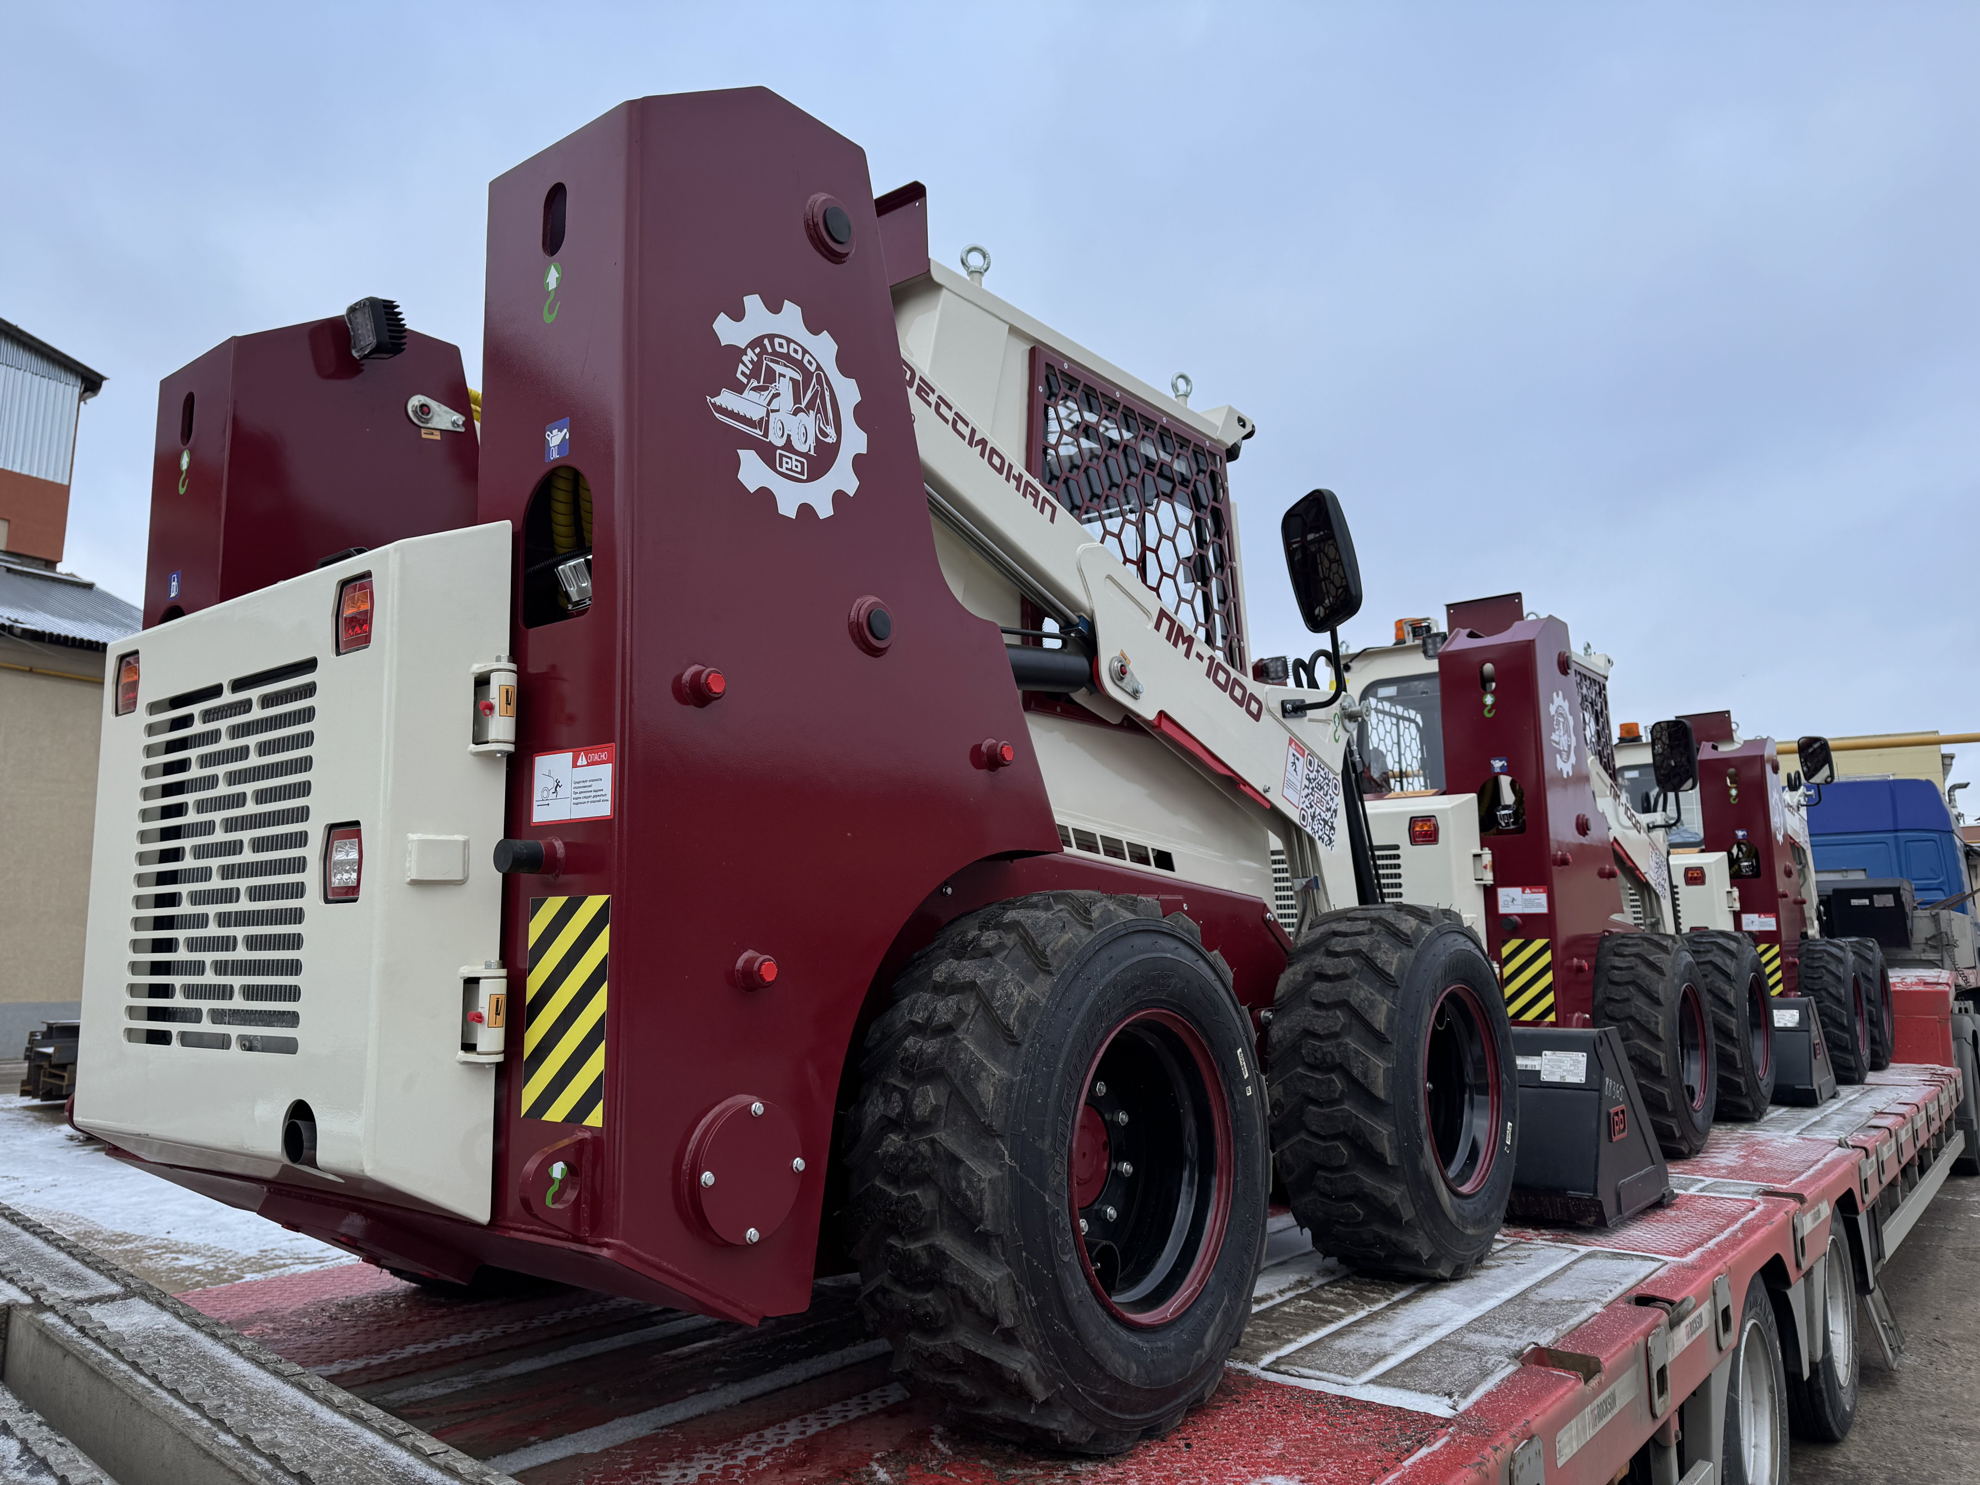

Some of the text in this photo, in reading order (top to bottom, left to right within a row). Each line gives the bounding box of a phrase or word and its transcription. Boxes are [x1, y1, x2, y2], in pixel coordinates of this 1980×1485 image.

[736, 337, 817, 385] ПМ-1000
[549, 446, 560, 460] OIL
[1153, 606, 1263, 722] ПМ-1000
[588, 752, 608, 762] ОПАСНО
[1610, 782, 1642, 835] ПМ-1000
